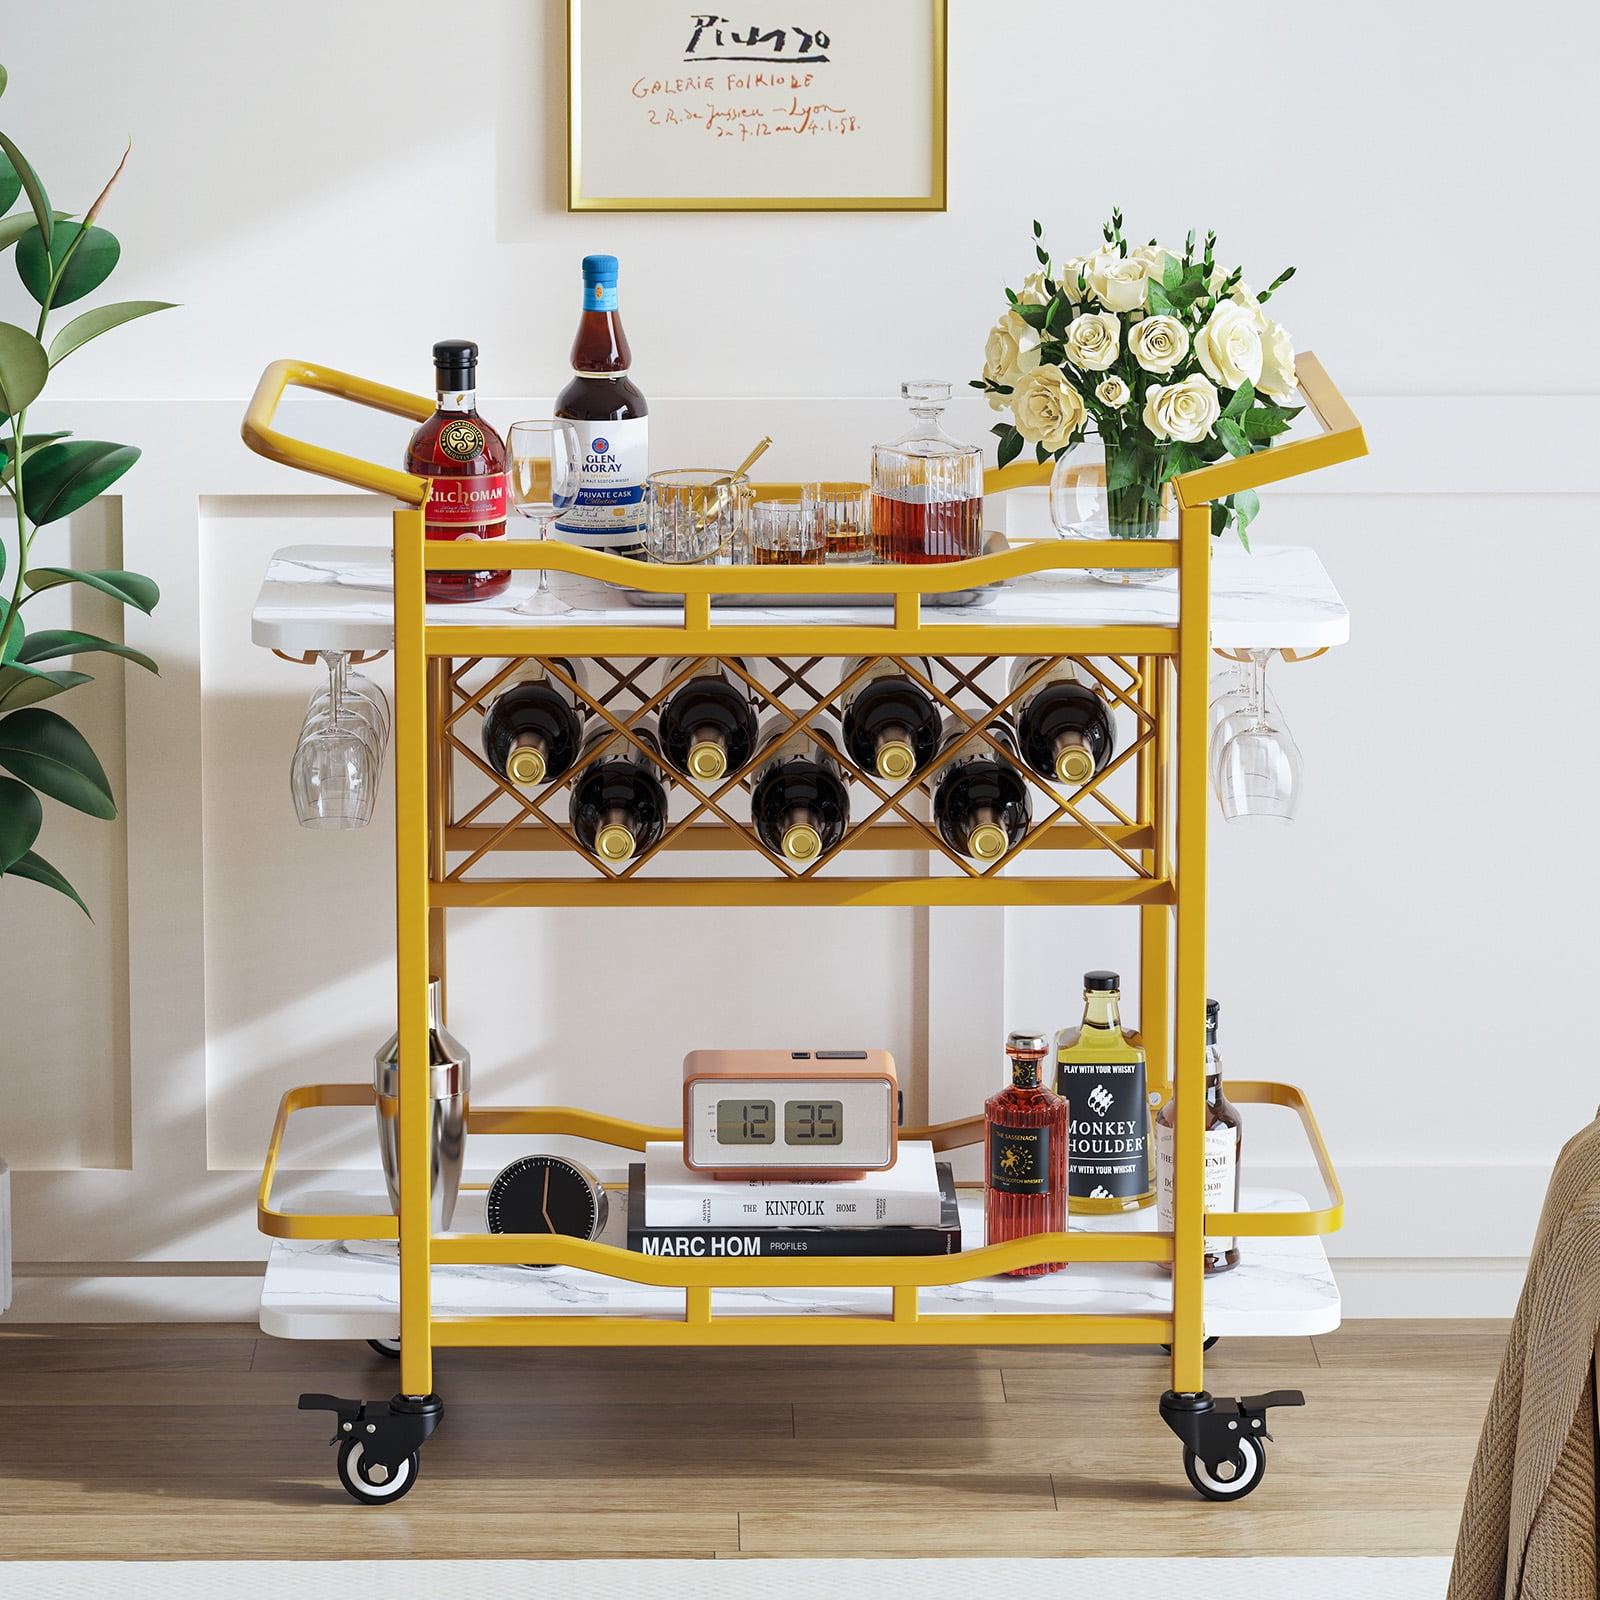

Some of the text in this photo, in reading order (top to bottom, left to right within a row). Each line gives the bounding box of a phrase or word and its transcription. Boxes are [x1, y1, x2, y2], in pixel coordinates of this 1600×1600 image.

[632, 75, 714, 98] GALERIE
[647, 110, 660, 124] 2
[586, 454, 615, 463] GLEN
[582, 464, 622, 473] MORAY
[579, 490, 632, 499] PRIVATE CASK
[1063, 1065, 1136, 1074] PLAY WITH YOUR WHISKY
[743, 1105, 837, 1138] 12 35
[1069, 1120, 1136, 1136] MONKEY
[1069, 1138, 1143, 1153] HOULDER
[1078, 1165, 1094, 1174] WITH
[1095, 1165, 1112, 1174] YOUR
[1113, 1164, 1136, 1174] WHISKY
[743, 1200, 857, 1216] THE KINFOLK HOME
[642, 1236, 808, 1257] MARC HOM PROFILES
